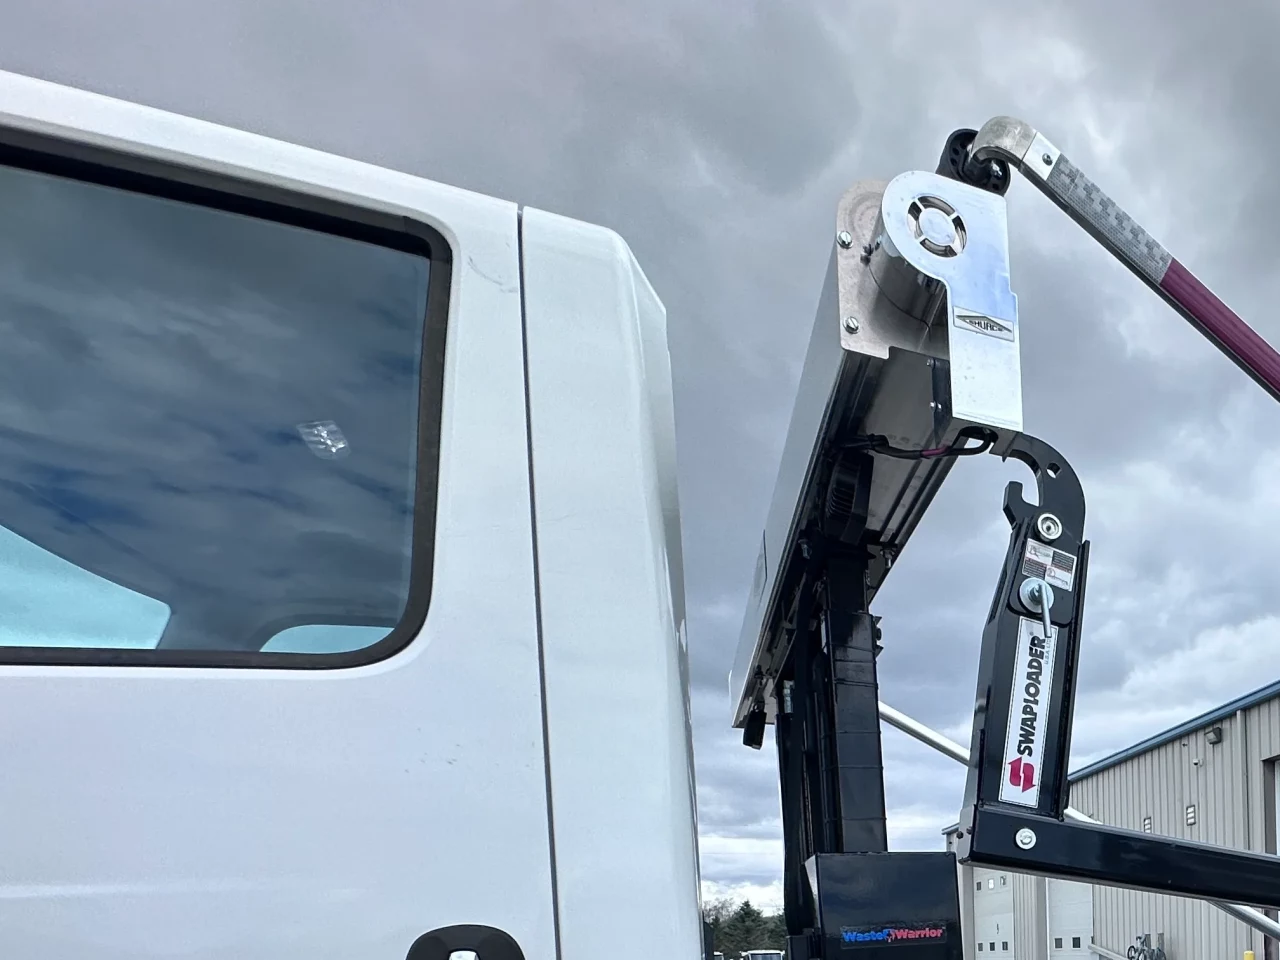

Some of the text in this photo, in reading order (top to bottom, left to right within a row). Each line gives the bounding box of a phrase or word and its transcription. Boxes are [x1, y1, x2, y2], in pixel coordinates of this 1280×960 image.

[1016, 635, 1046, 757] SWAPLOADER
[842, 927, 943, 943] Waste Warrior
